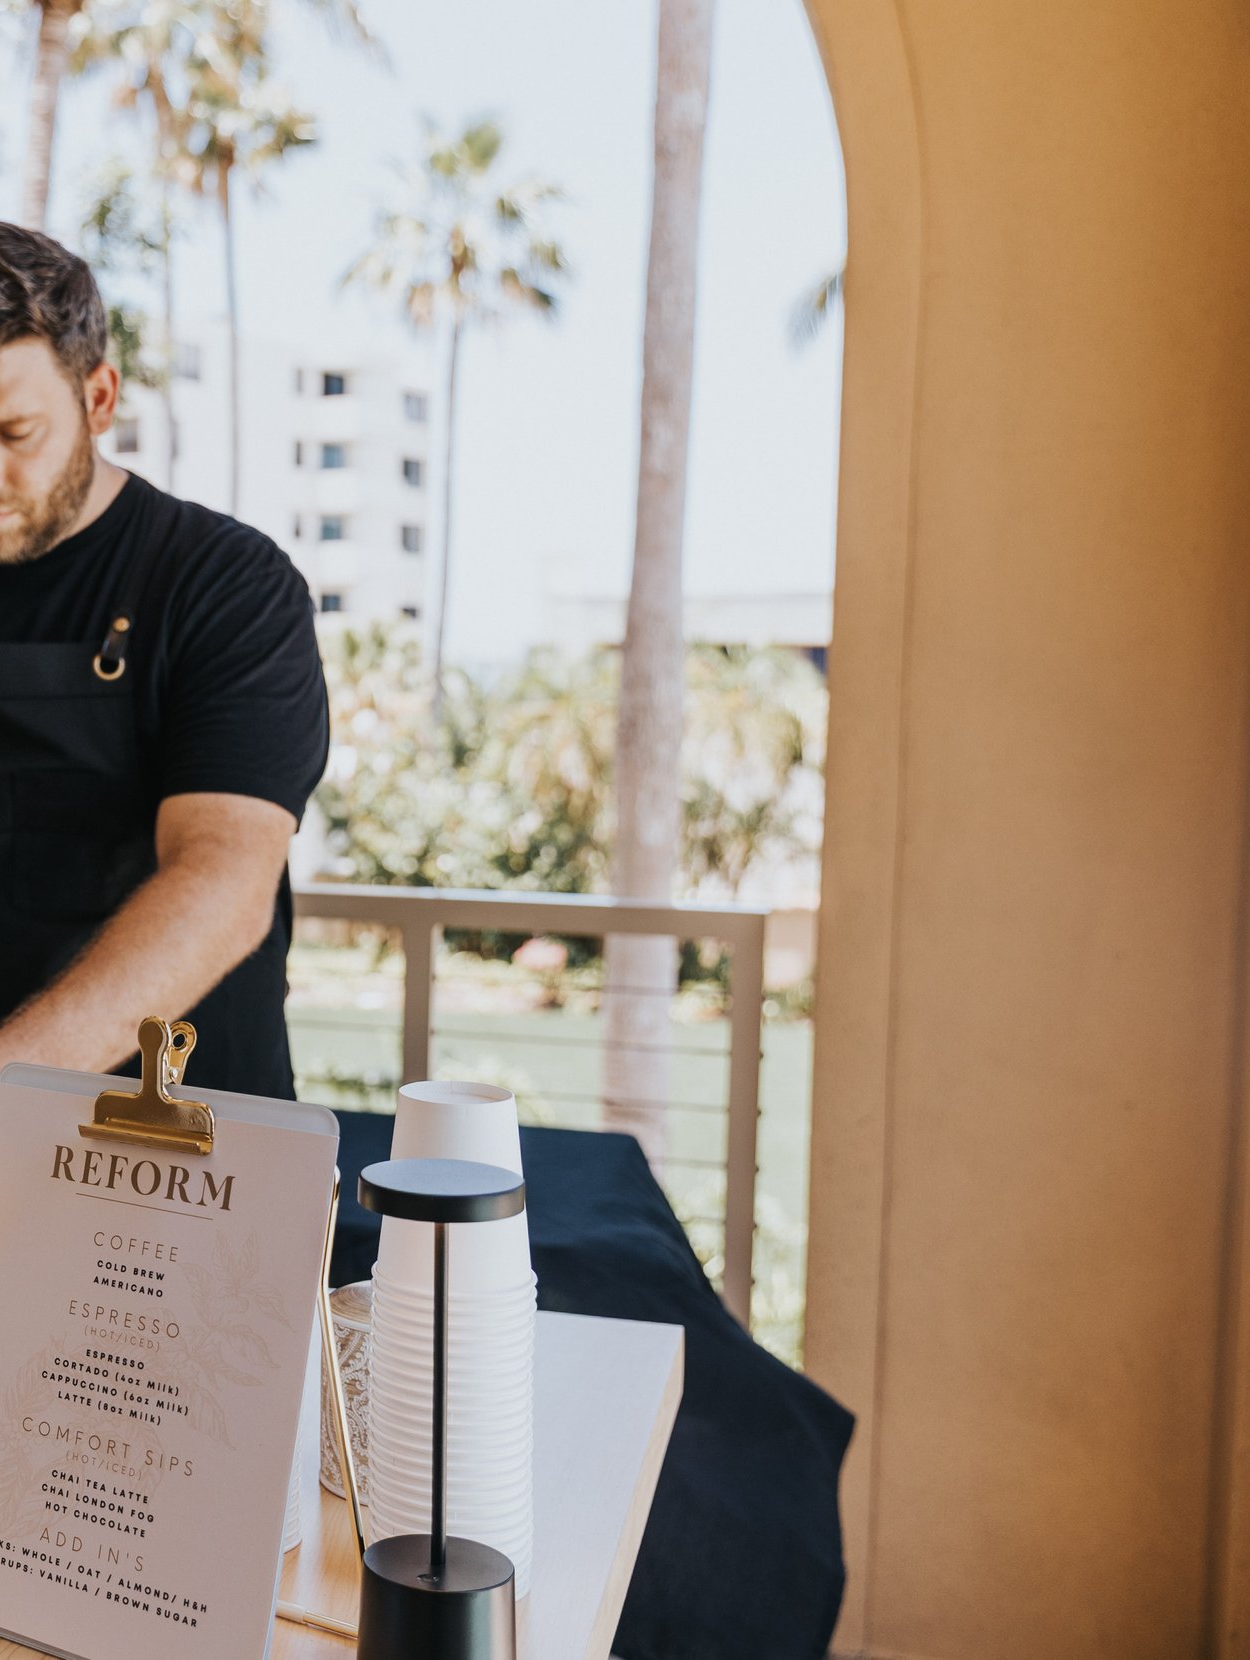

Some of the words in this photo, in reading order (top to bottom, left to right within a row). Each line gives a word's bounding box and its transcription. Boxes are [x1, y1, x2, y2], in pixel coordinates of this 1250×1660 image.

[51, 1145, 236, 1211] REFORM
[93, 1231, 179, 1262] COFFEE
[93, 1276, 163, 1298] AMERICANO
[97, 1260, 127, 1273] COLD
[133, 1268, 165, 1281] BREW
[69, 1300, 180, 1338] ESPRESSO
[84, 1325, 160, 1353] (HOT/ICED)
[54, 1357, 109, 1378] CORTADO
[115, 1372, 140, 1386] (4oz
[147, 1381, 179, 1397] Milk)
[86, 1349, 145, 1370] ESPRESSO
[41, 1370, 117, 1397] CAPPUCCINO
[124, 1390, 149, 1405] (6oz
[156, 1400, 189, 1416] Milk)
[58, 1391, 92, 1406] LATTE
[98, 1400, 123, 1415] (8oz
[129, 1409, 161, 1426] Milk)
[22, 1416, 130, 1459] COMFORT
[144, 1450, 193, 1477] SIPS
[65, 1450, 143, 1480] (HOT/ICED)
[41, 1483, 69, 1498] CHAI
[75, 1493, 124, 1514] LONDON
[130, 1509, 154, 1523] FOG
[51, 1469, 79, 1484] CHAI
[86, 1479, 106, 1492] TEA
[112, 1487, 149, 1504] LATTE
[45, 1501, 68, 1514] HOT
[73, 1510, 146, 1538] CHOCOLATE
[39, 1527, 83, 1552] ADD
[97, 1544, 144, 1572] IN'S
[21, 1547, 61, 1567] WHOLE
[77, 1565, 101, 1579] OAT
[183, 1598, 207, 1613] H&H
[39, 1569, 89, 1592] VANILLA
[106, 1591, 149, 1612] BROWN
[156, 1607, 197, 1628] SUGAR
